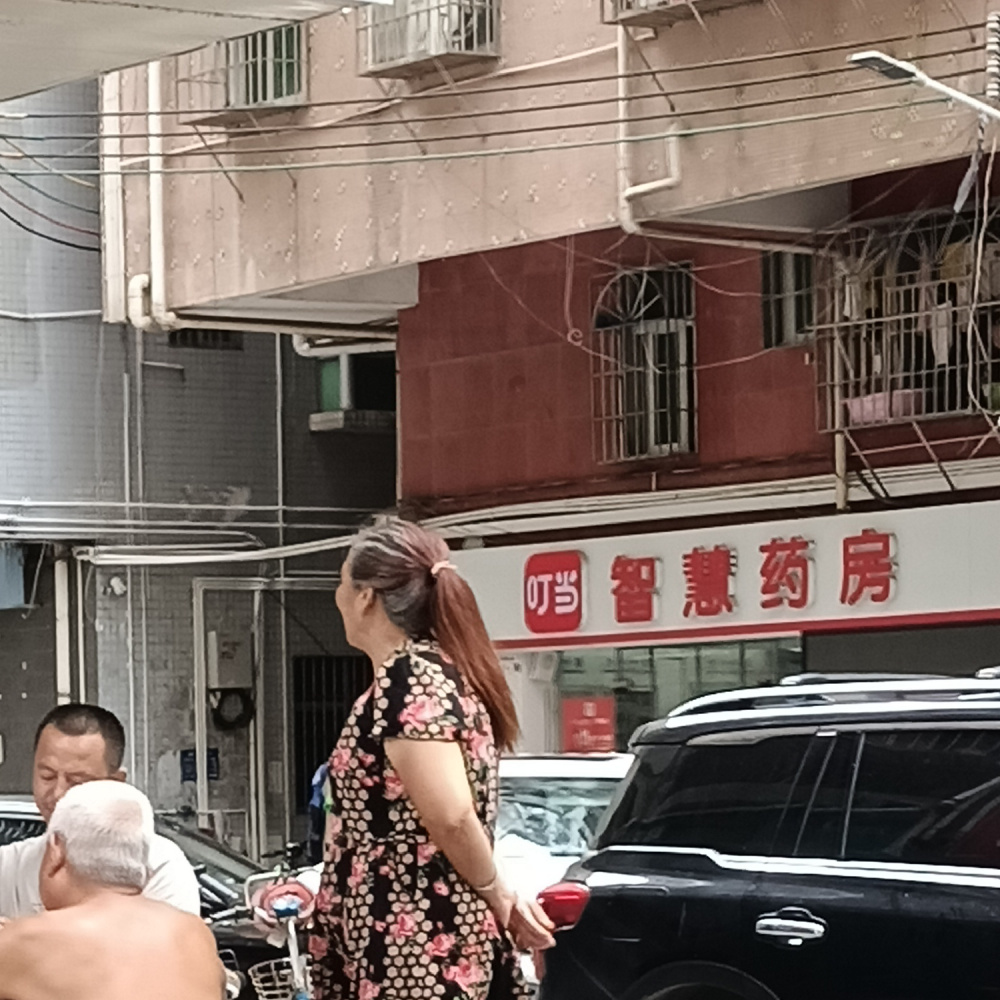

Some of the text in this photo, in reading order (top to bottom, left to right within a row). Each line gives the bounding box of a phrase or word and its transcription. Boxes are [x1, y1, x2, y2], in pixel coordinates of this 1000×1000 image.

[526, 528, 896, 624] 叮当 智慧药房
